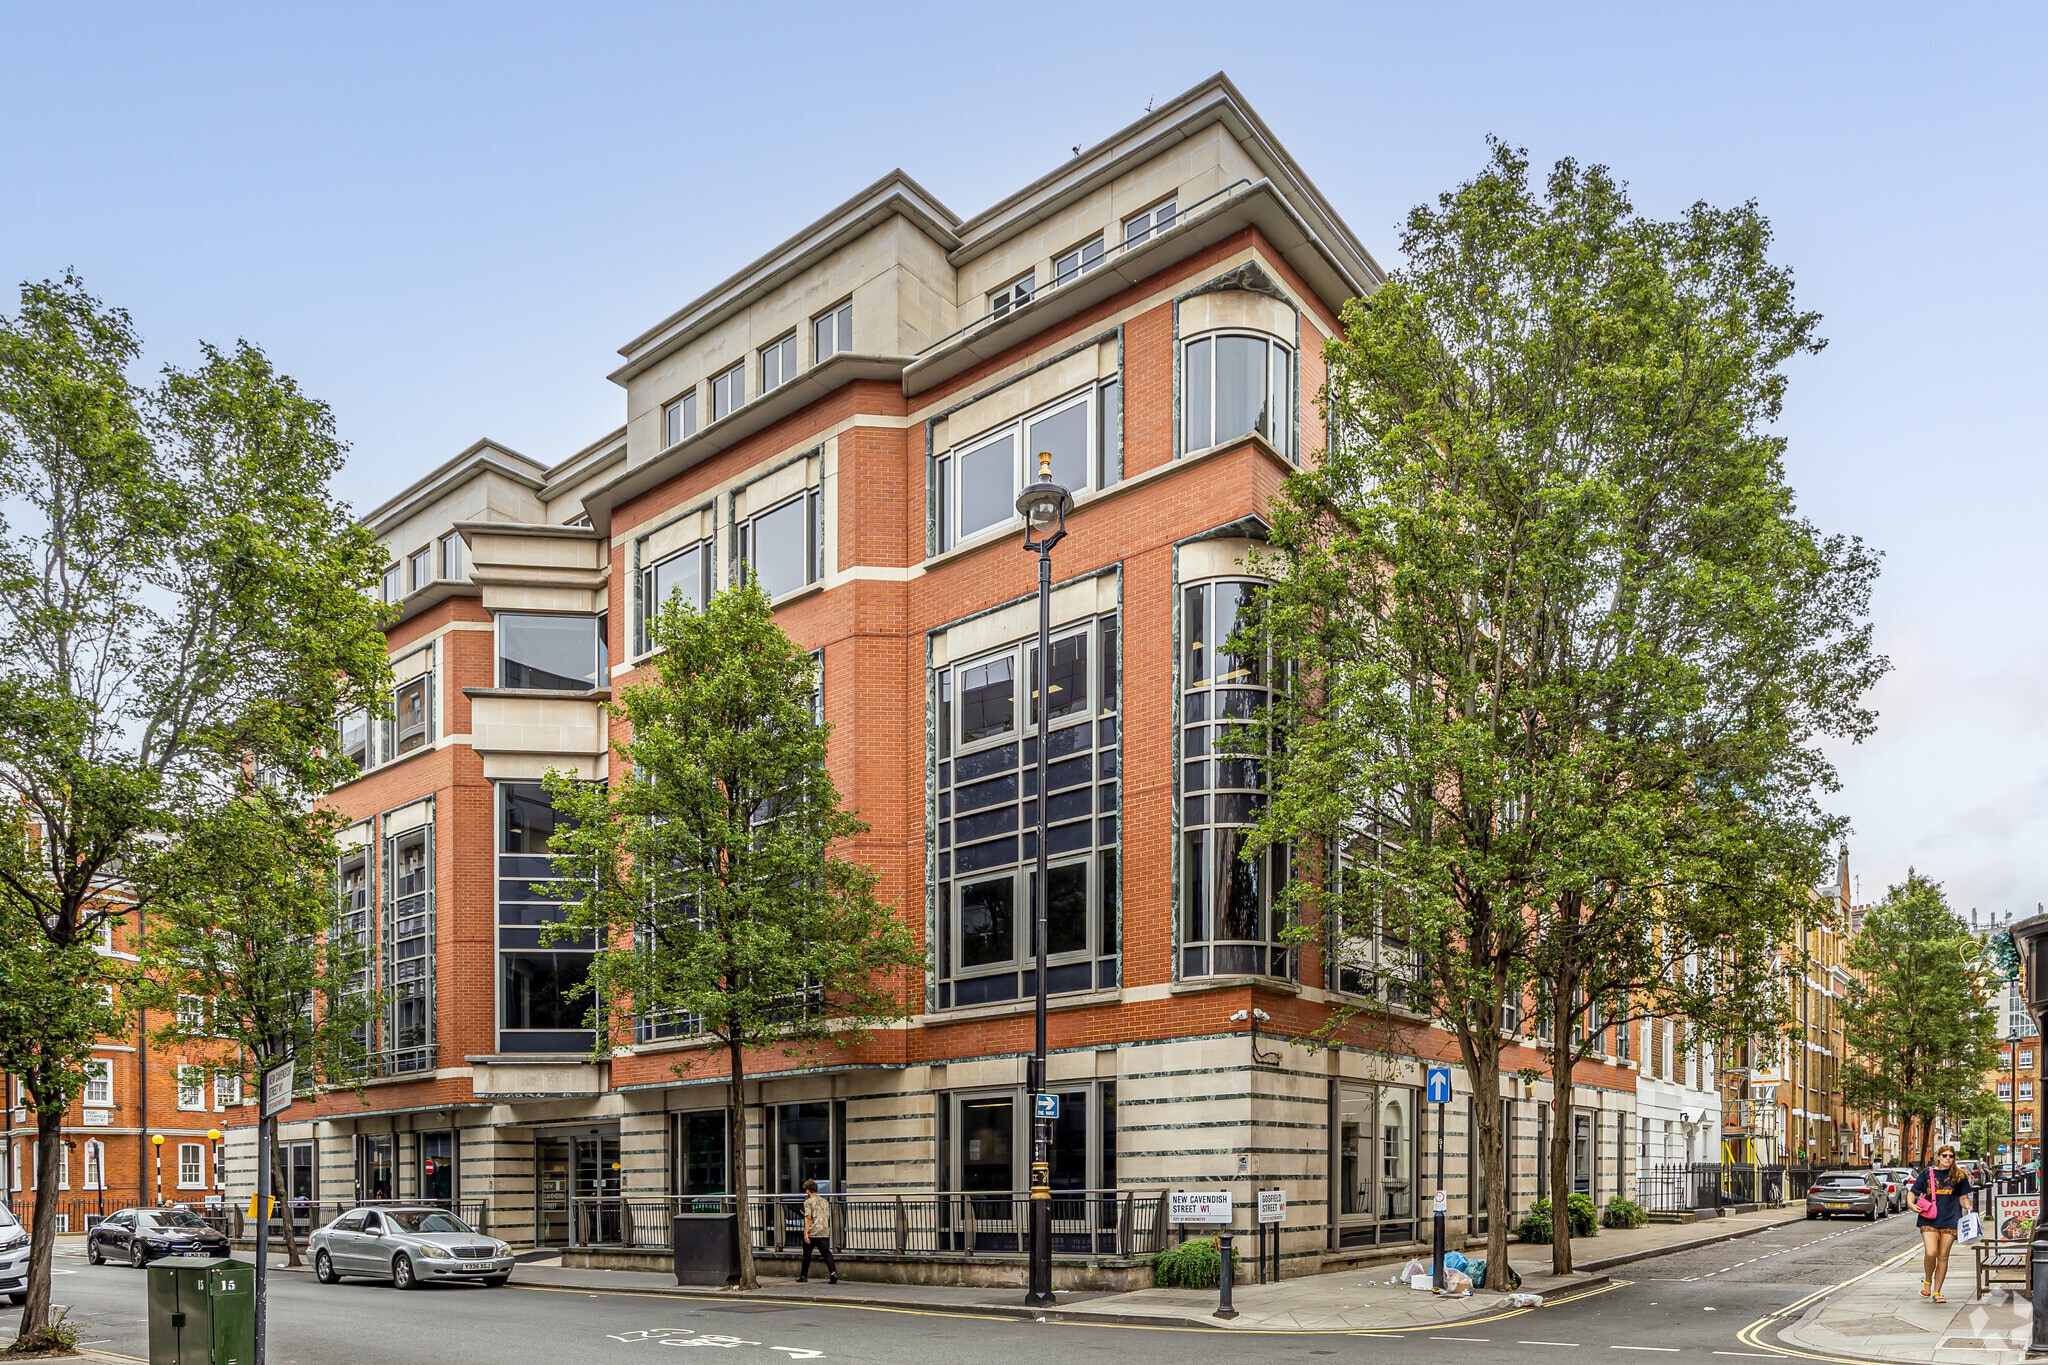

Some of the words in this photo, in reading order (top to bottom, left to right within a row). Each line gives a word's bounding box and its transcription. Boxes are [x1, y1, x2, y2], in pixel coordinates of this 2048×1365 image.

[1172, 1195, 1188, 1204] NEW
[1189, 1195, 1228, 1204] CAVENDISH
[1262, 1194, 1282, 1203] GOSFIELD
[1172, 1204, 1197, 1213] STREET
[1200, 1204, 1210, 1213] W1
[1262, 1204, 1278, 1213] STREET
[2004, 1208, 2039, 1217] POKÉ
[221, 1280, 236, 1291] 15
